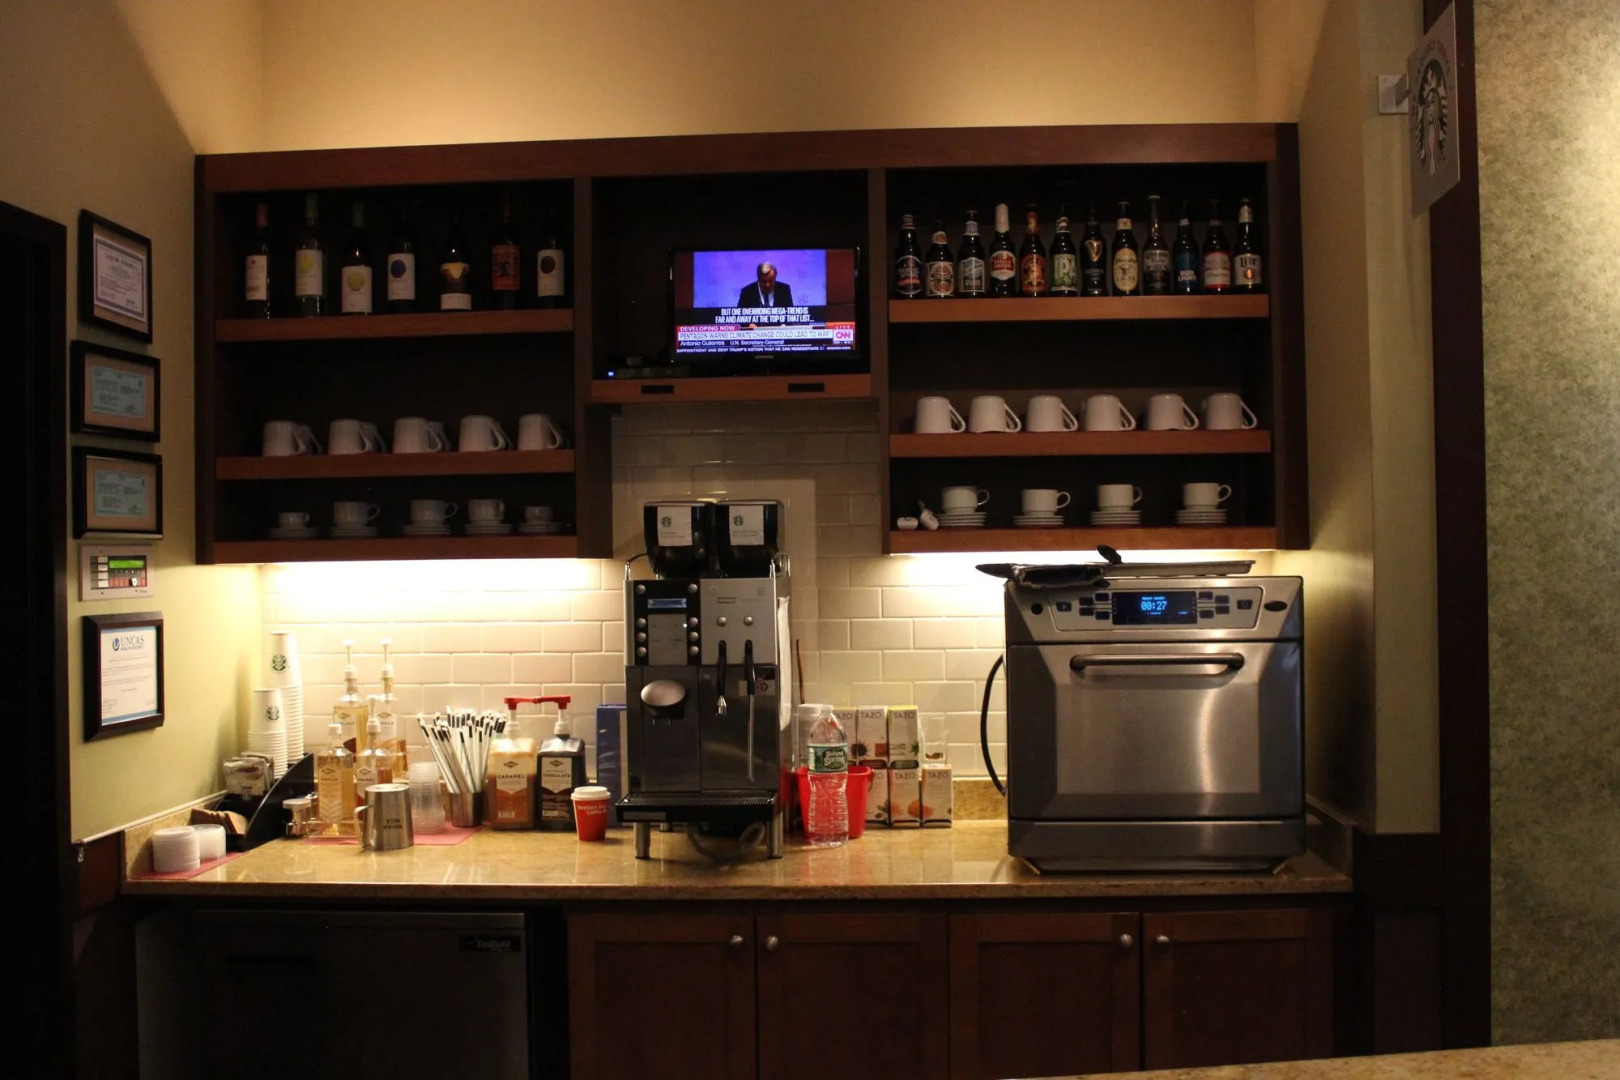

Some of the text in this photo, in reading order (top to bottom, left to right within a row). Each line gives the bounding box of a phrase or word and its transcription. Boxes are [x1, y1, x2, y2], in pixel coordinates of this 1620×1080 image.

[1054, 257, 1076, 279] IPA
[721, 308, 731, 316] BUT
[752, 315, 761, 323] AT
[1141, 601, 1167, 610] 00:27
[121, 636, 144, 646] UNCAS
[860, 711, 881, 719] TAZO
[894, 711, 915, 719] TAZO
[824, 756, 846, 767] Spring
[928, 771, 949, 779] TAZO
